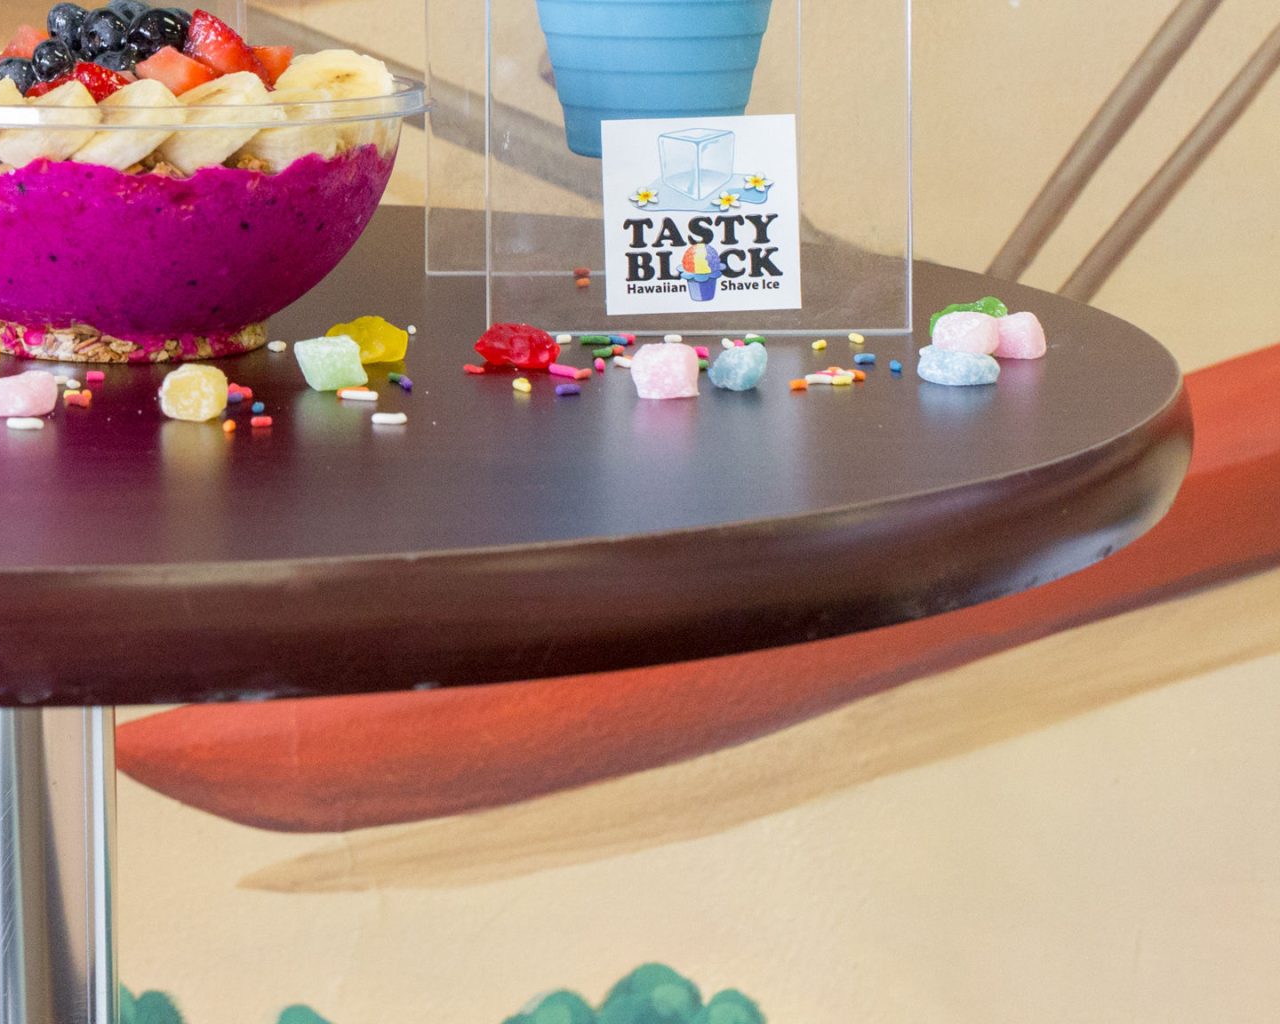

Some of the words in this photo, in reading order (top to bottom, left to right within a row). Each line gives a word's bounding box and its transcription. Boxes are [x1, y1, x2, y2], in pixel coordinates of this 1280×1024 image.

[622, 213, 779, 249] TASTY
[624, 246, 784, 282] BLCK
[626, 282, 688, 295] Hawaiian
[720, 280, 760, 292] Shave
[762, 278, 781, 290] Ice
